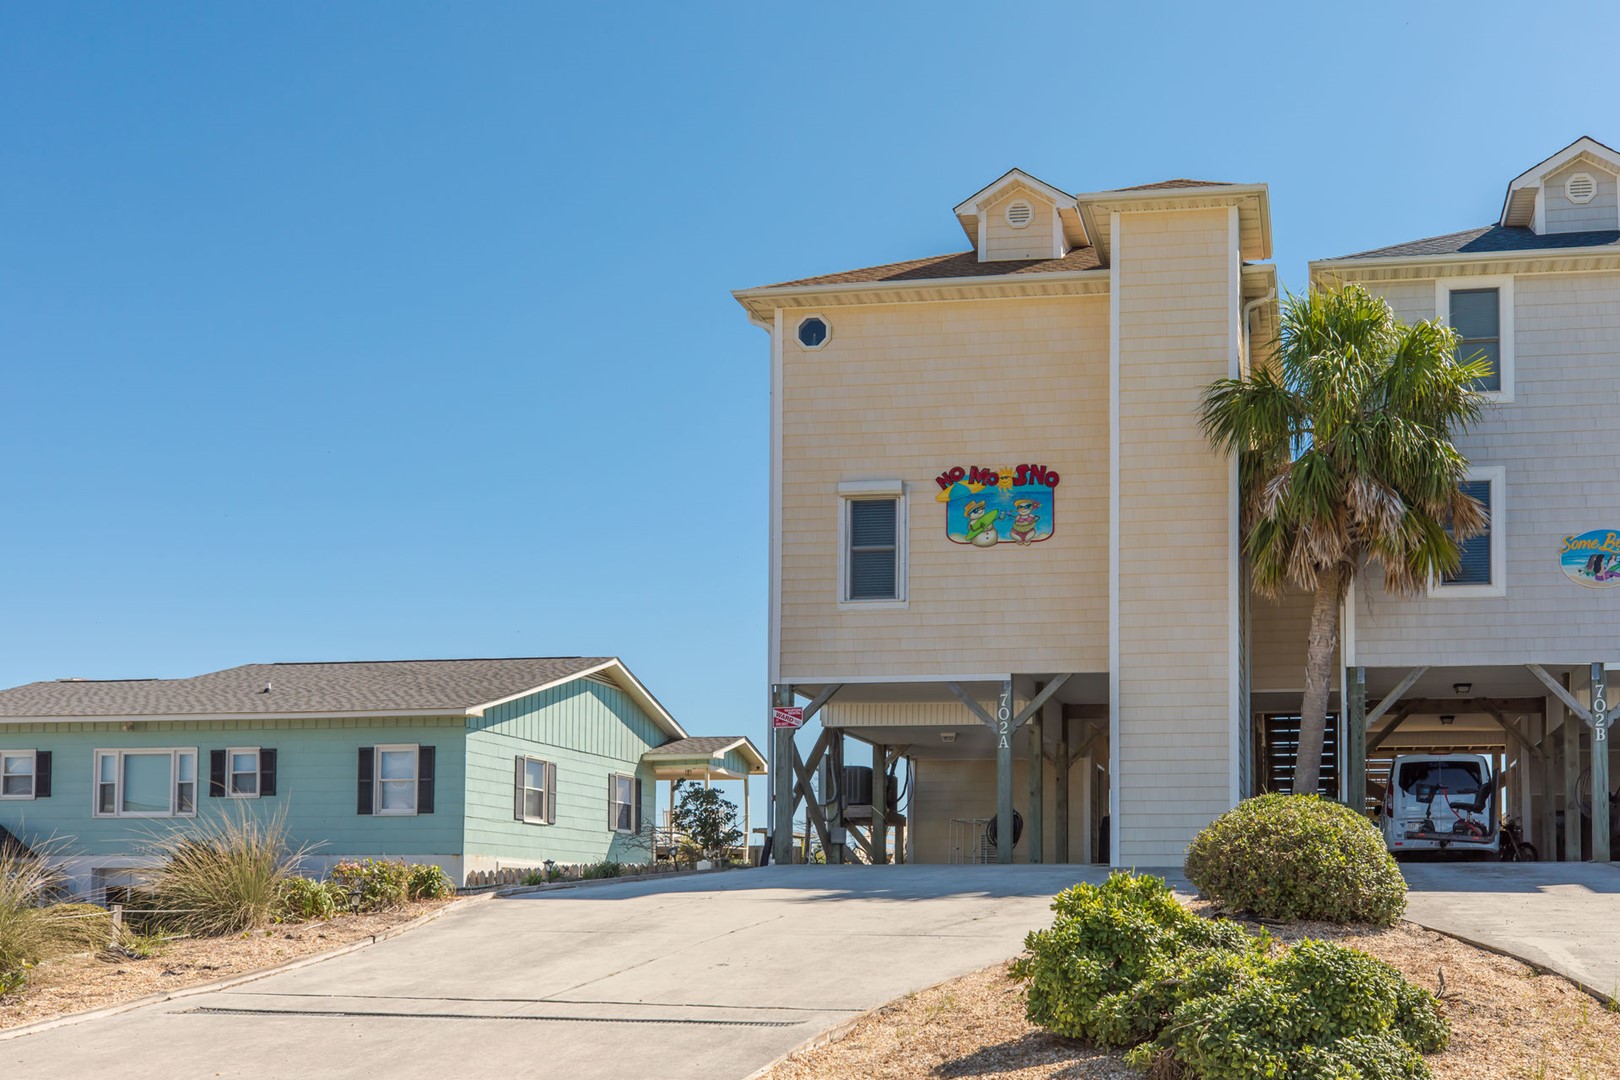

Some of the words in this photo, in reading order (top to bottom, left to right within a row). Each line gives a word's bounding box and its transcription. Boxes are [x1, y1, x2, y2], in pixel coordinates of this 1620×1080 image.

[935, 466, 965, 490] NO
[1012, 464, 1059, 488] SNO
[1560, 534, 1599, 553] Some
[776, 712, 794, 722] WARD
[998, 693, 1009, 749] 702A
[1593, 684, 1606, 741] 702B
